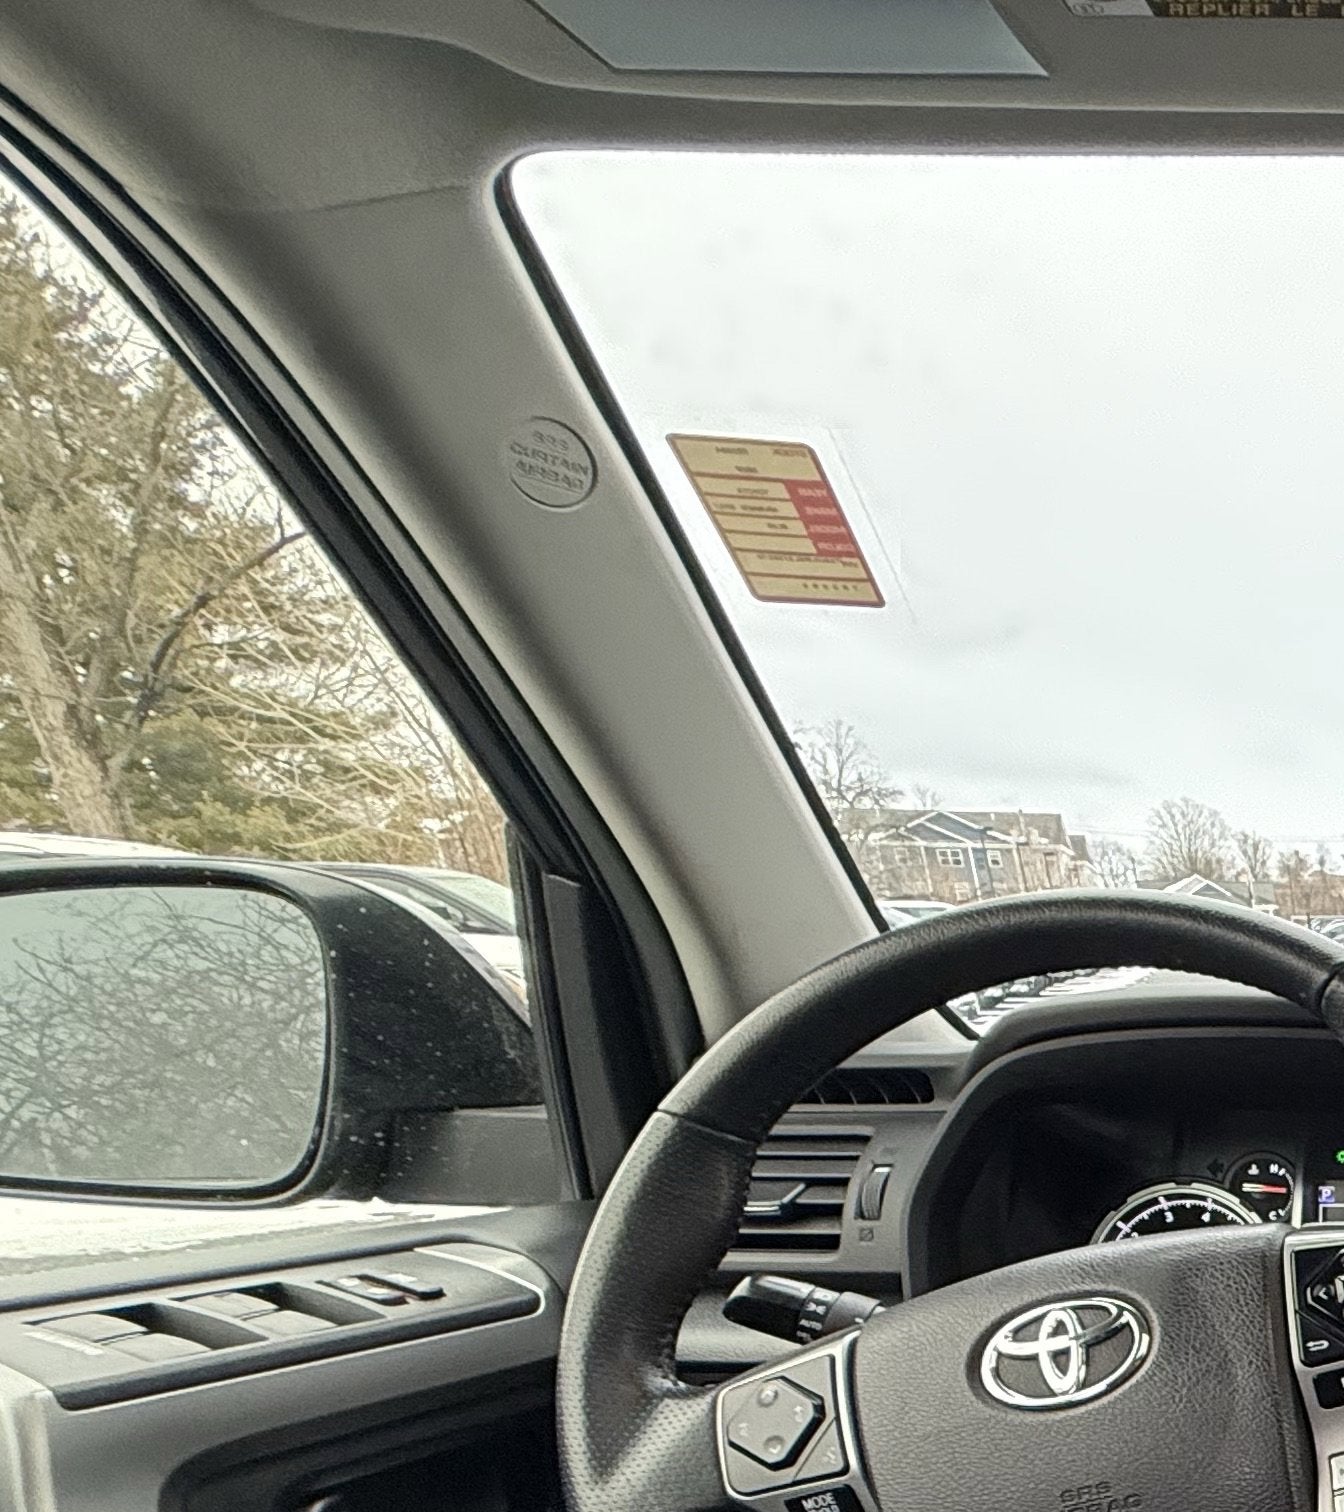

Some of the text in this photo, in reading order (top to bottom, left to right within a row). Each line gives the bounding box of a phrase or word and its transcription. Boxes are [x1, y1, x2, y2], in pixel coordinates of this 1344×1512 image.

[1169, 3, 1270, 17] REPLIER
[1291, 4, 1319, 17] LE
[1164, 1211, 1211, 1223] 3 4
[801, 1493, 837, 1510] MODE
